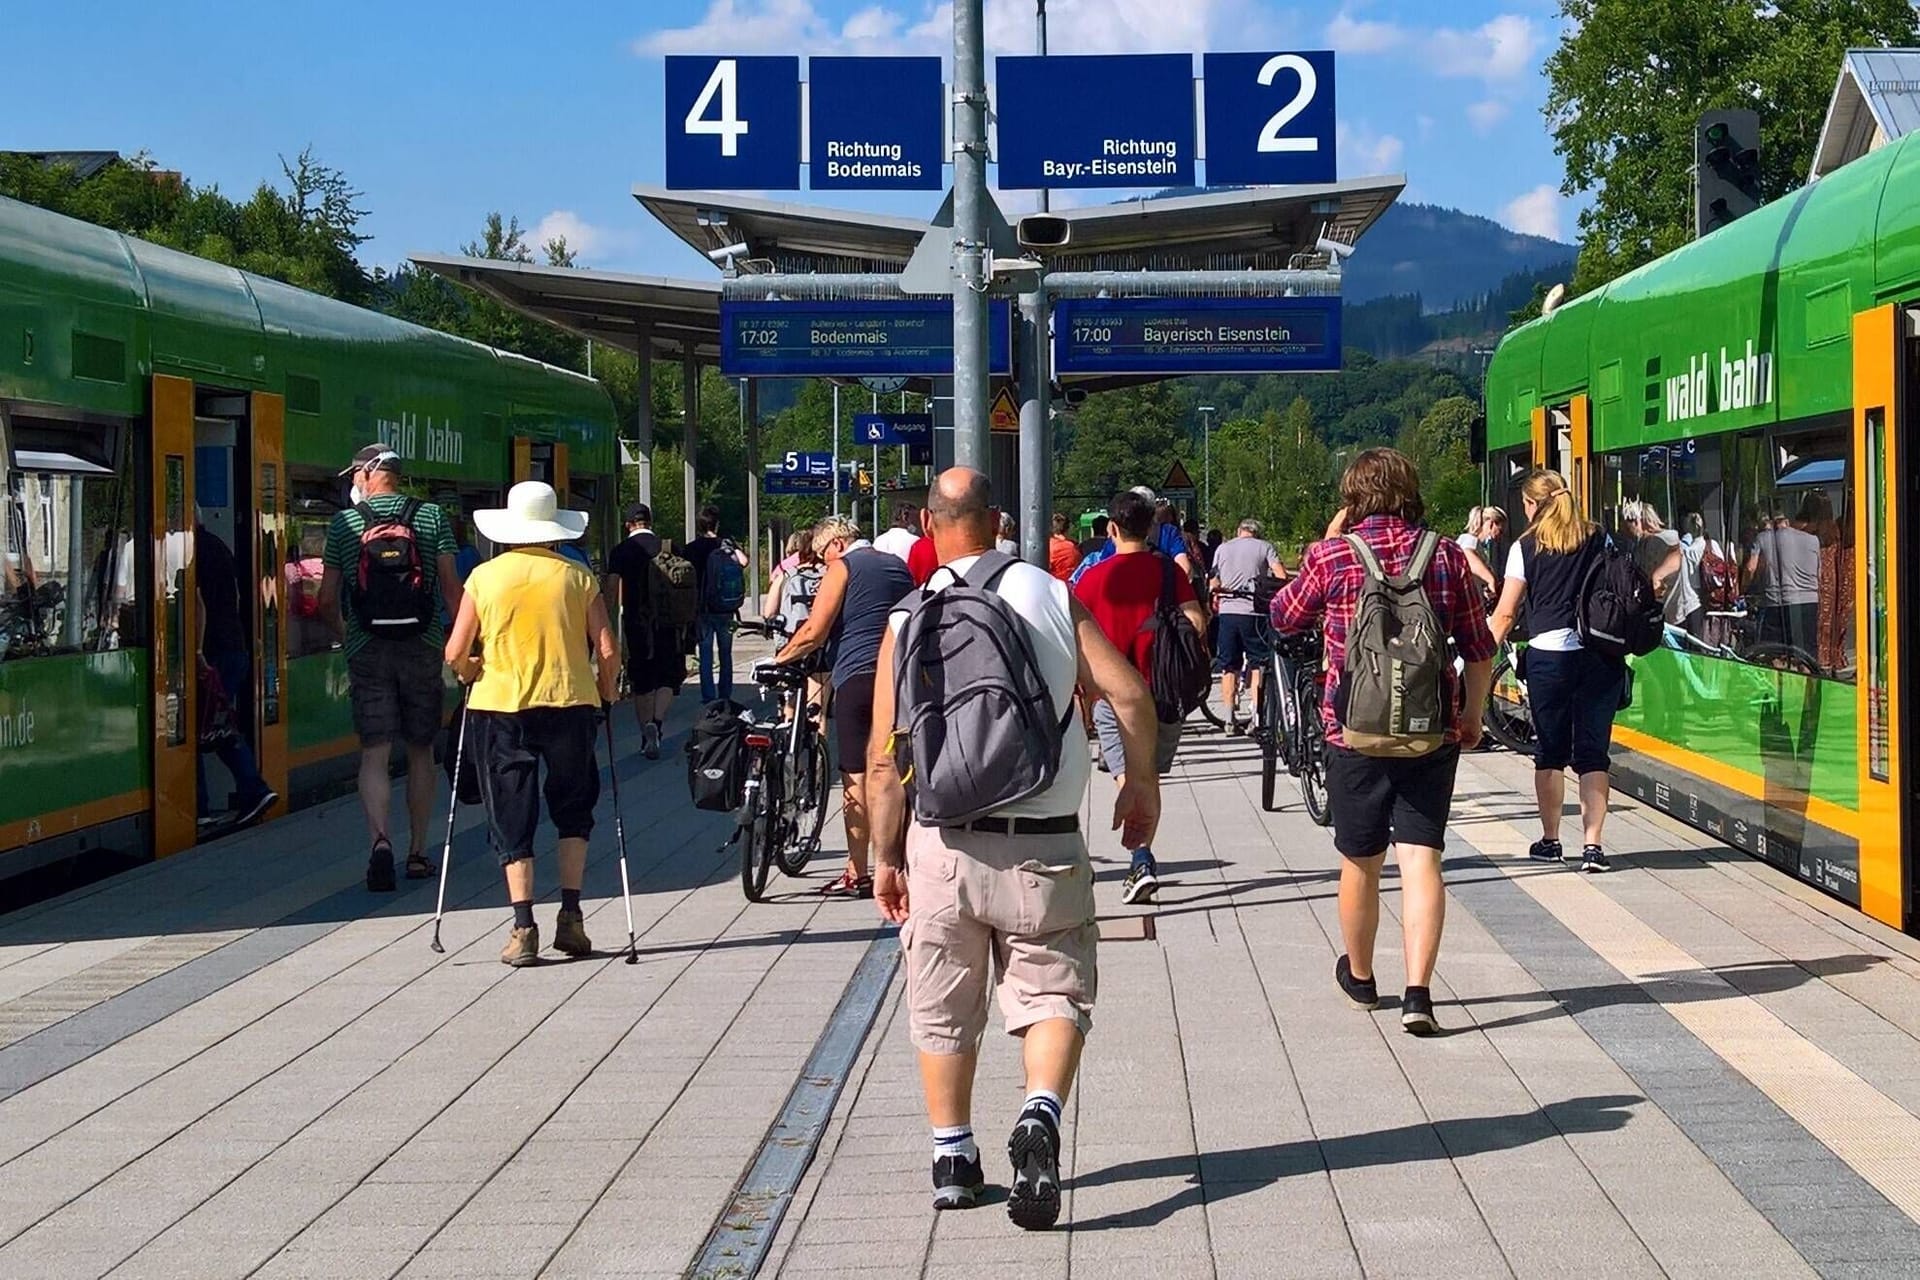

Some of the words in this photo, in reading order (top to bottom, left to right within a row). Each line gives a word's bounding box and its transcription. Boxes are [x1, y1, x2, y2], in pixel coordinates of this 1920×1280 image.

[685, 59, 748, 156] 4
[1257, 54, 1318, 152] 2
[827, 141, 901, 159] Richtung
[1103, 139, 1176, 157] Richtung
[827, 162, 922, 177] Bodenmais
[1043, 159, 1177, 179] Bayr.-Eisenstein
[740, 330, 778, 345] 17:02
[811, 330, 888, 344] Bodenmais
[1073, 328, 1111, 342] 17:00
[1144, 327, 1213, 344] Bayerisch
[1218, 326, 1290, 341] Eisenstein
[1666, 352, 1708, 423] wald
[1719, 339, 1773, 412] bahn
[377, 411, 416, 460] wald
[426, 415, 462, 464] bahn
[785, 451, 799, 471] 5
[0, 696, 35, 747] n.de
